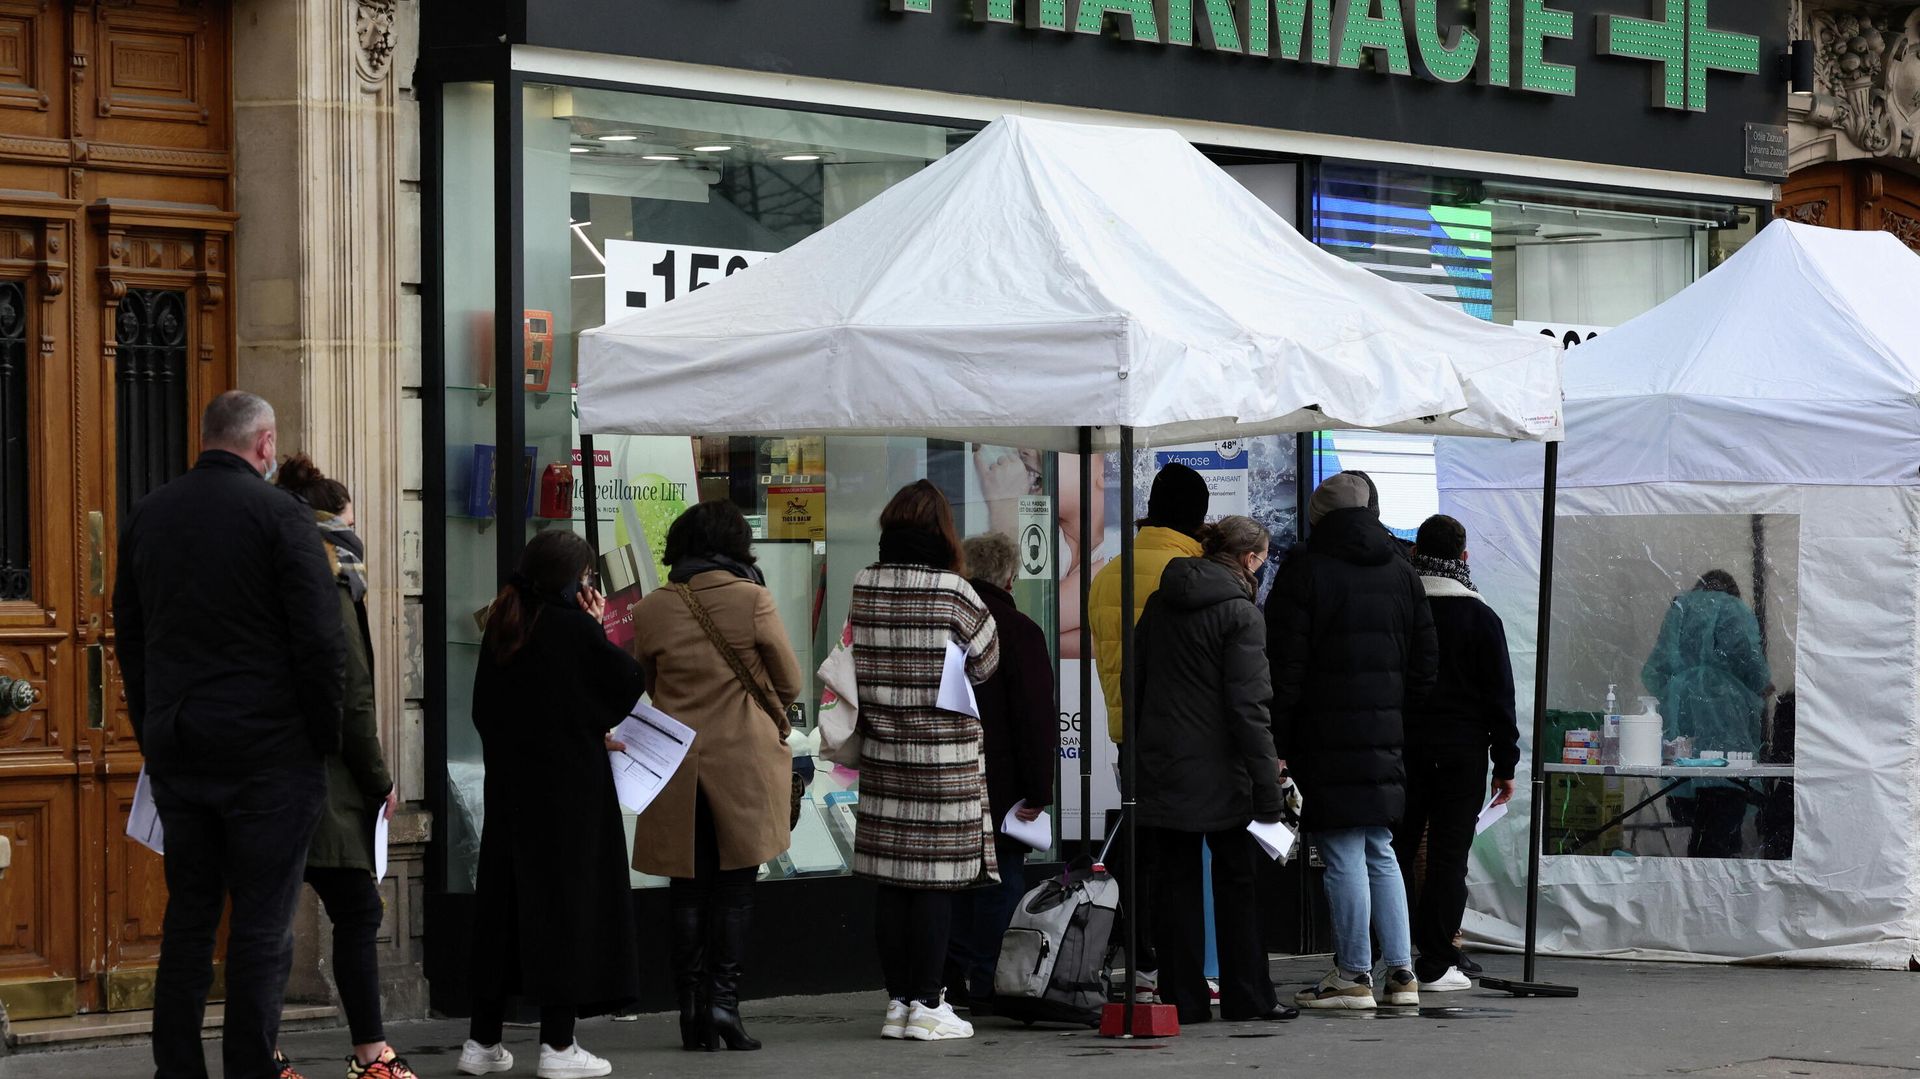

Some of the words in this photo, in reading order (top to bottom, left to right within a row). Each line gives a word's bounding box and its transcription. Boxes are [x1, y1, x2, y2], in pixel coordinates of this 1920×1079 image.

[904, 0, 1576, 97] MACIE
[626, 250, 767, 308] -15
[1167, 454, 1210, 466] Xémose
[661, 482, 688, 501] LIFT
